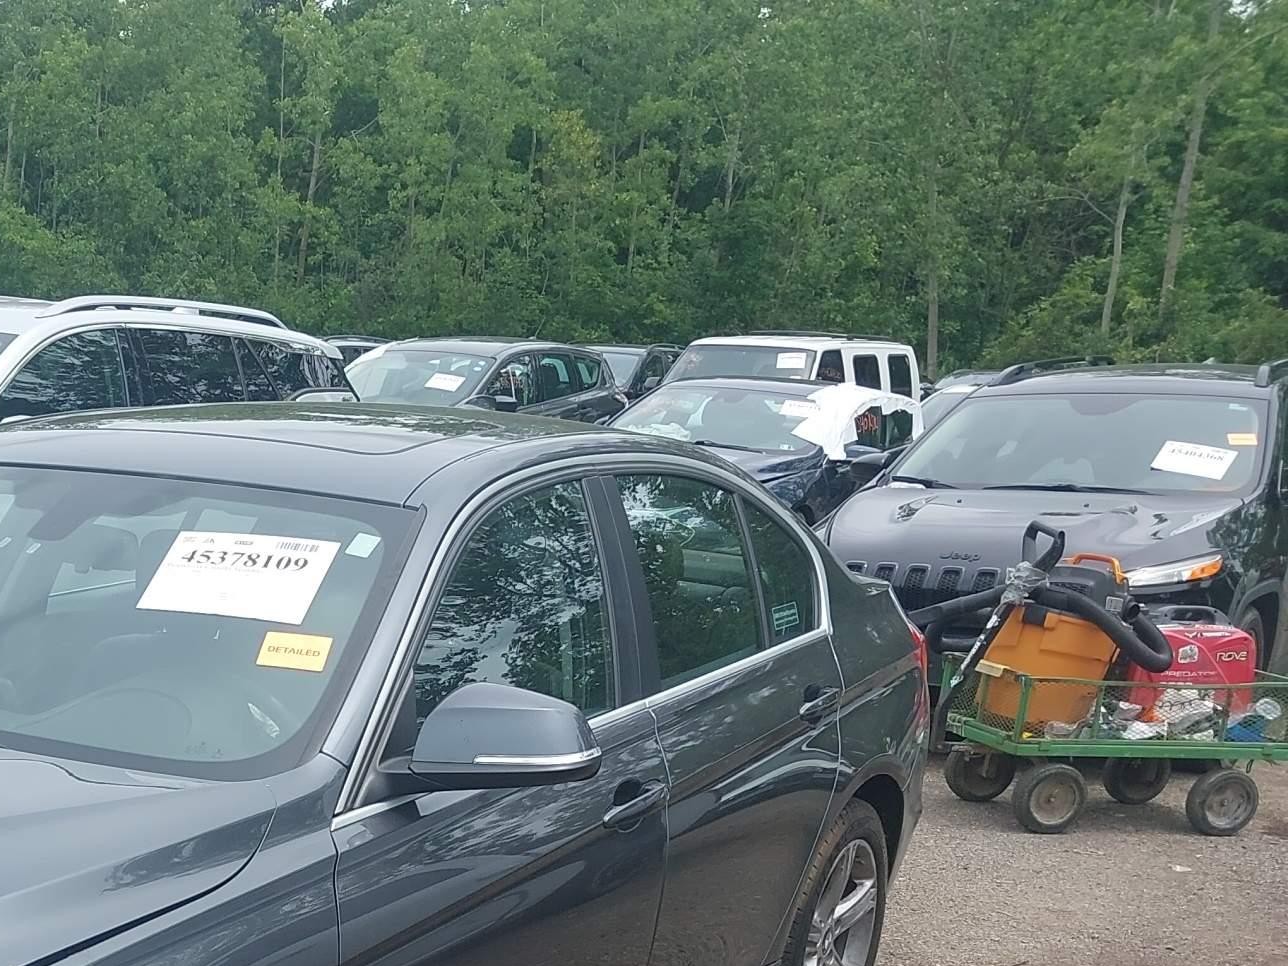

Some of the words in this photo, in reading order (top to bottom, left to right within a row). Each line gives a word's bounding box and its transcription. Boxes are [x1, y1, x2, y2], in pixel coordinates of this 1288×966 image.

[180, 549, 309, 572] 45378109
[938, 551, 983, 563] Jeep
[267, 644, 321, 658] DETAILED
[1216, 651, 1247, 661] ROVE
